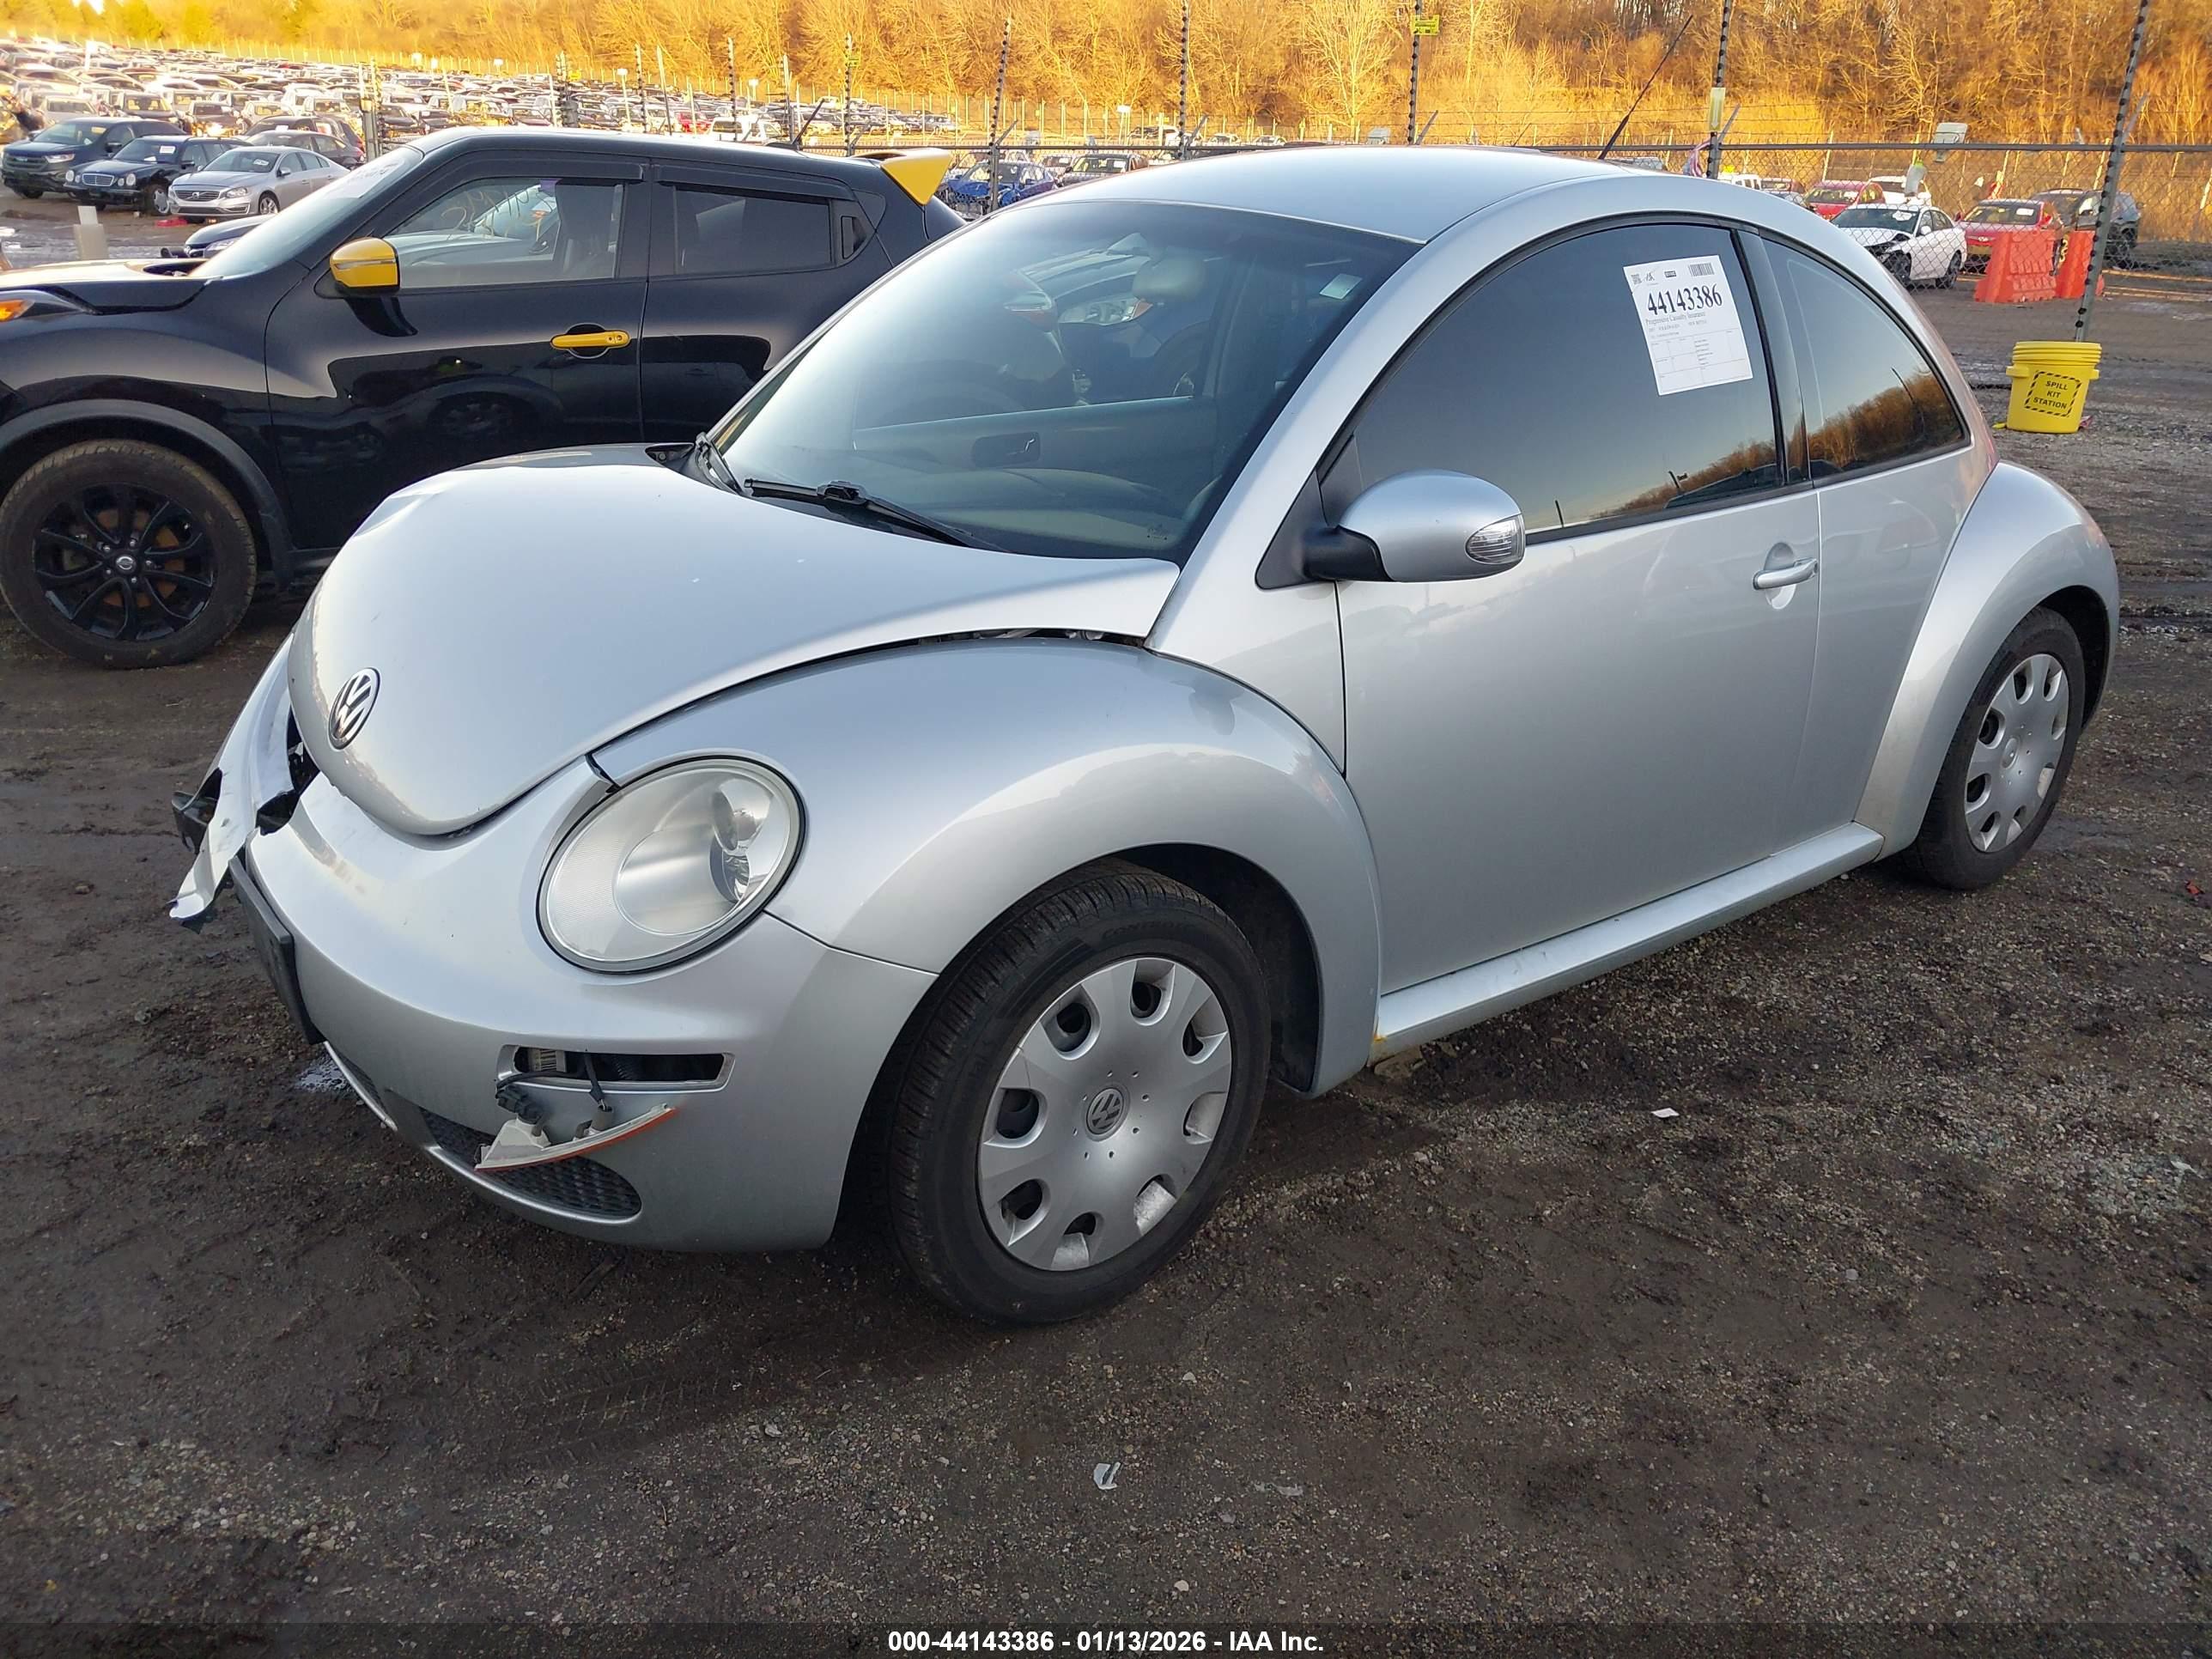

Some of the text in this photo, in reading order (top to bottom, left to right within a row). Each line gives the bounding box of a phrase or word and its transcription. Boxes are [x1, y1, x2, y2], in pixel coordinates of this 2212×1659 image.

[1648, 283, 1723, 315] 44143386
[2045, 380, 2069, 391] SPILL
[2046, 390, 2062, 398] KIT
[2033, 397, 2068, 410] STATION
